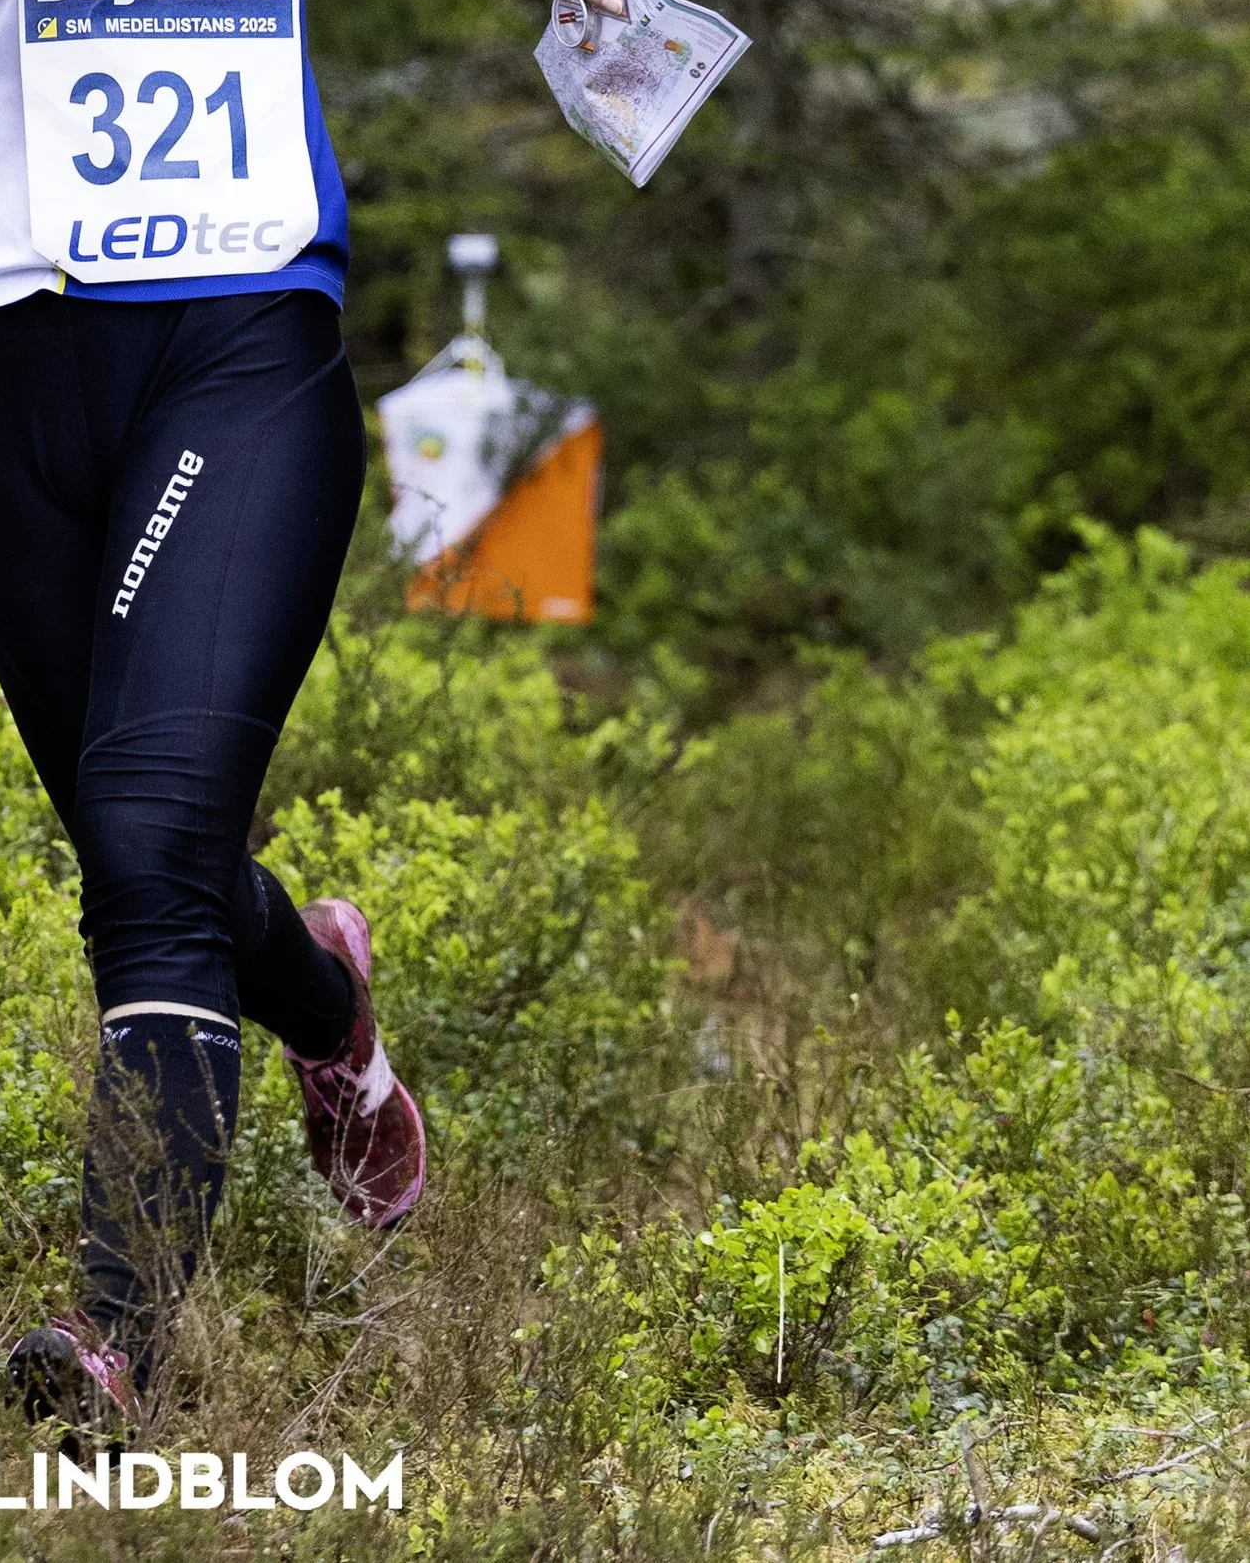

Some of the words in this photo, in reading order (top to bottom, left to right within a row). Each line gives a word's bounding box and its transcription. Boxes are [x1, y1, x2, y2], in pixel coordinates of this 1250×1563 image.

[65, 18, 92, 34] SM
[105, 17, 236, 33] MEDELDISTANS
[239, 17, 277, 33] 2025
[69, 71, 249, 185] 321
[111, 449, 204, 619] noname
